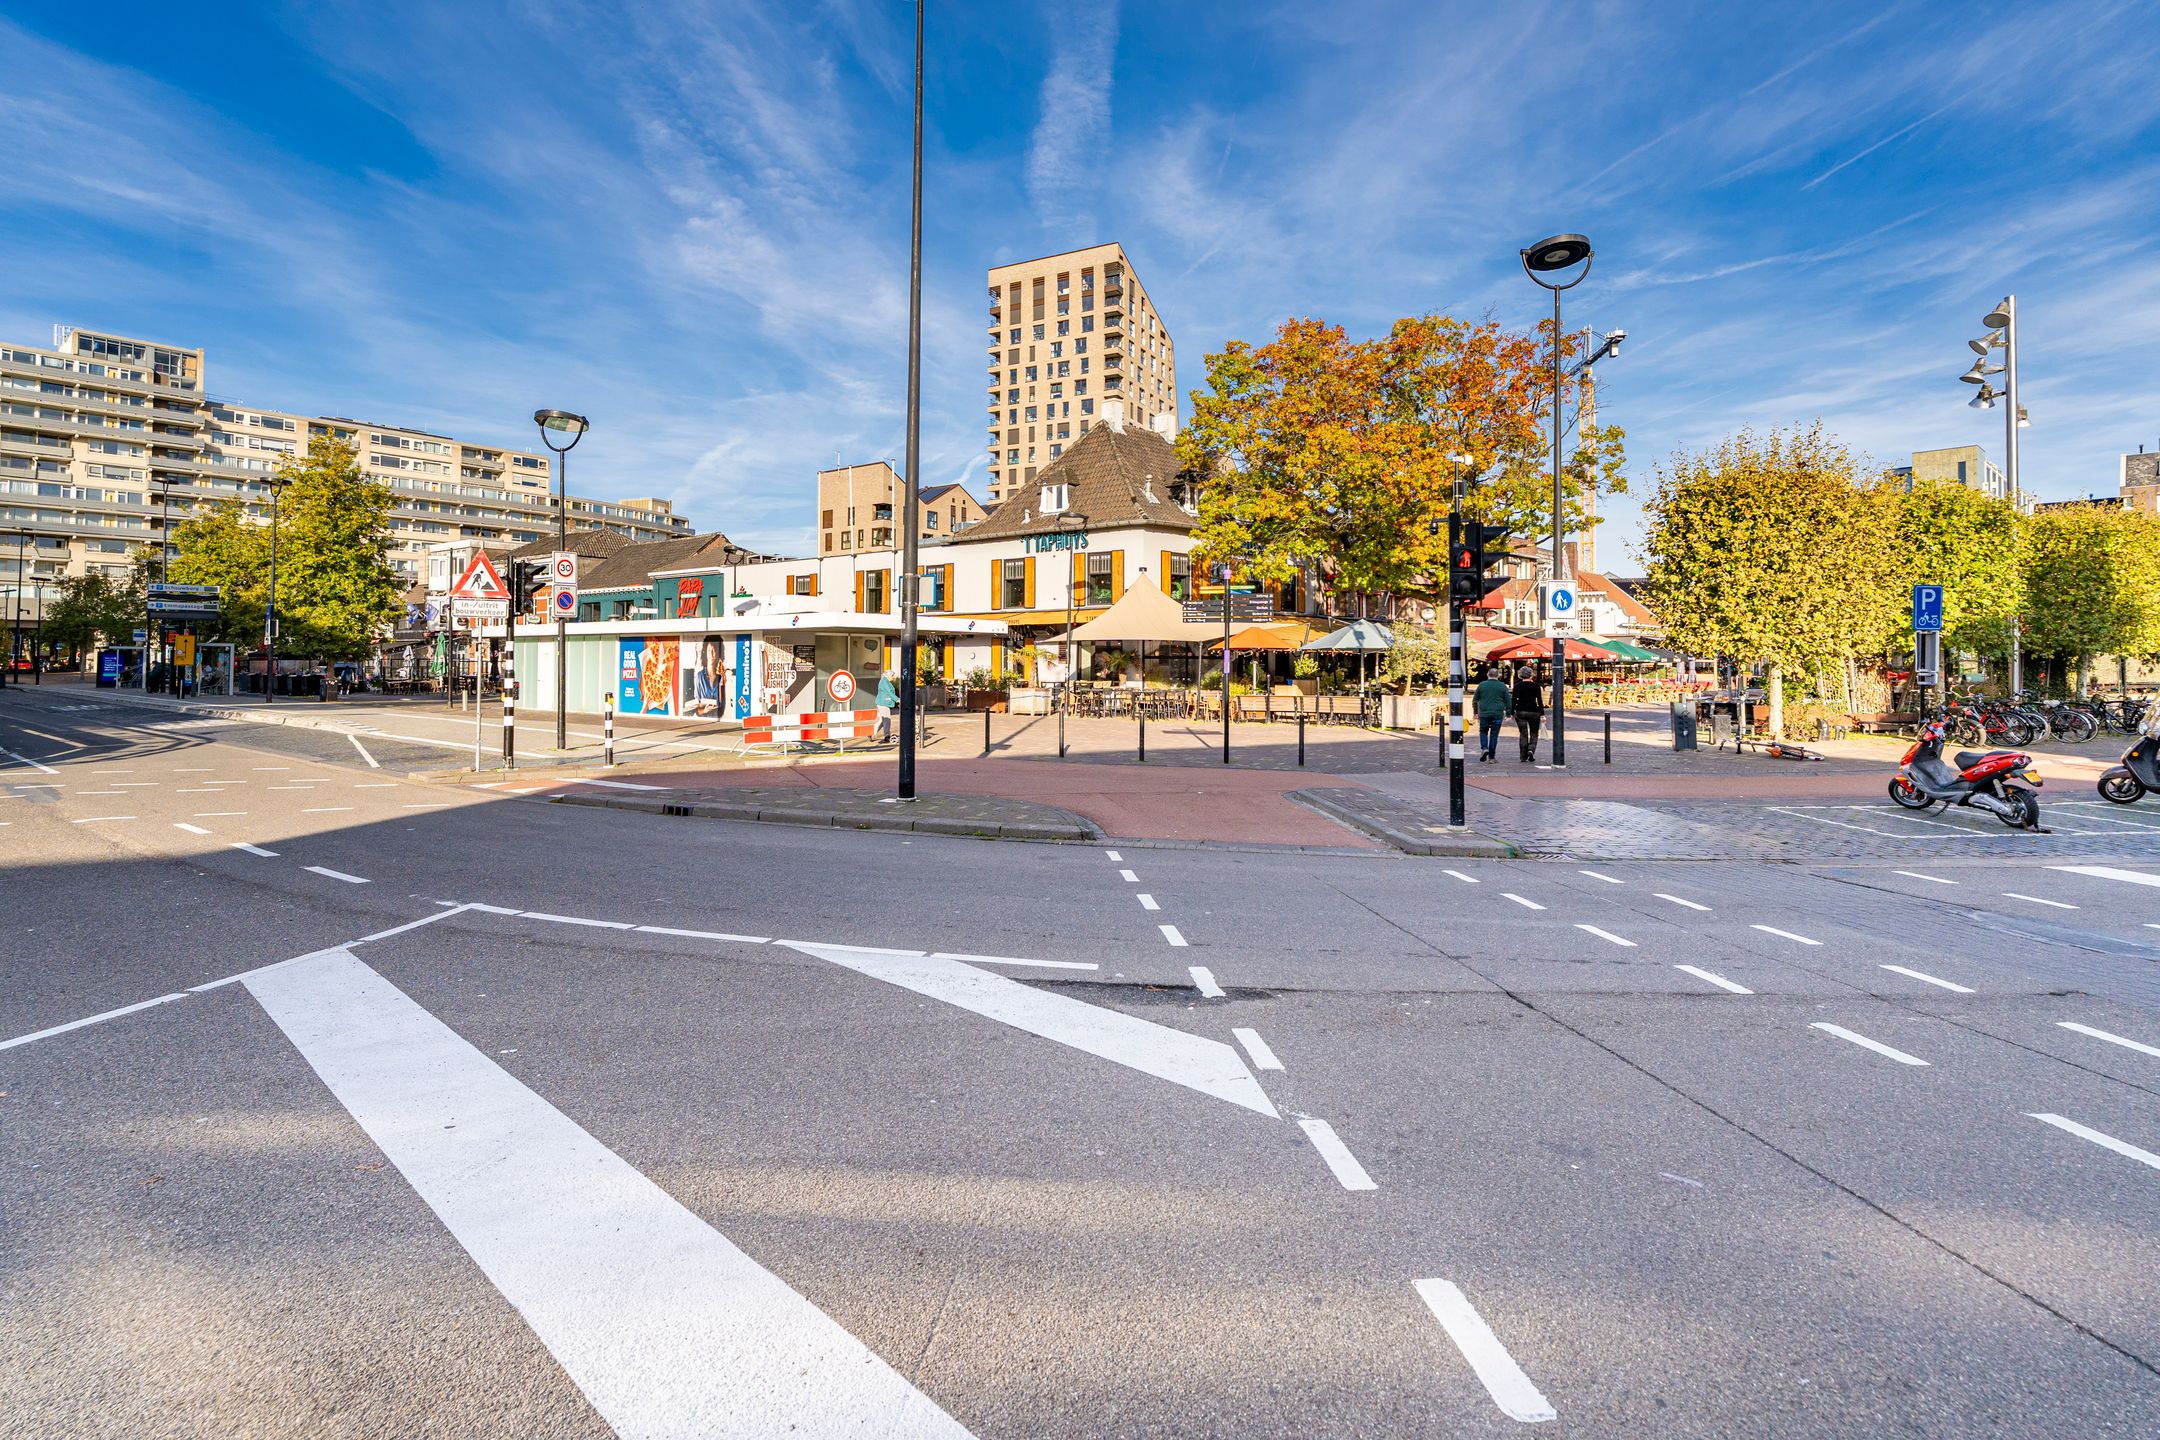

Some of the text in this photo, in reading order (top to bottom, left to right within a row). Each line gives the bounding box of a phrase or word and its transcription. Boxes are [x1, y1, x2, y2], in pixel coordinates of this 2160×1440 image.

[1032, 531, 1089, 553] TAPHUYS
[560, 563, 571, 572] 30
[678, 577, 704, 599] PAPA
[1921, 589, 1936, 610] P
[461, 601, 499, 609] in-/uitrit
[455, 608, 505, 616] bouwverkeer
[623, 650, 636, 659] REAL
[742, 639, 750, 695] Domino's
[767, 662, 791, 671] OESN'T
[767, 680, 789, 689] USHED
